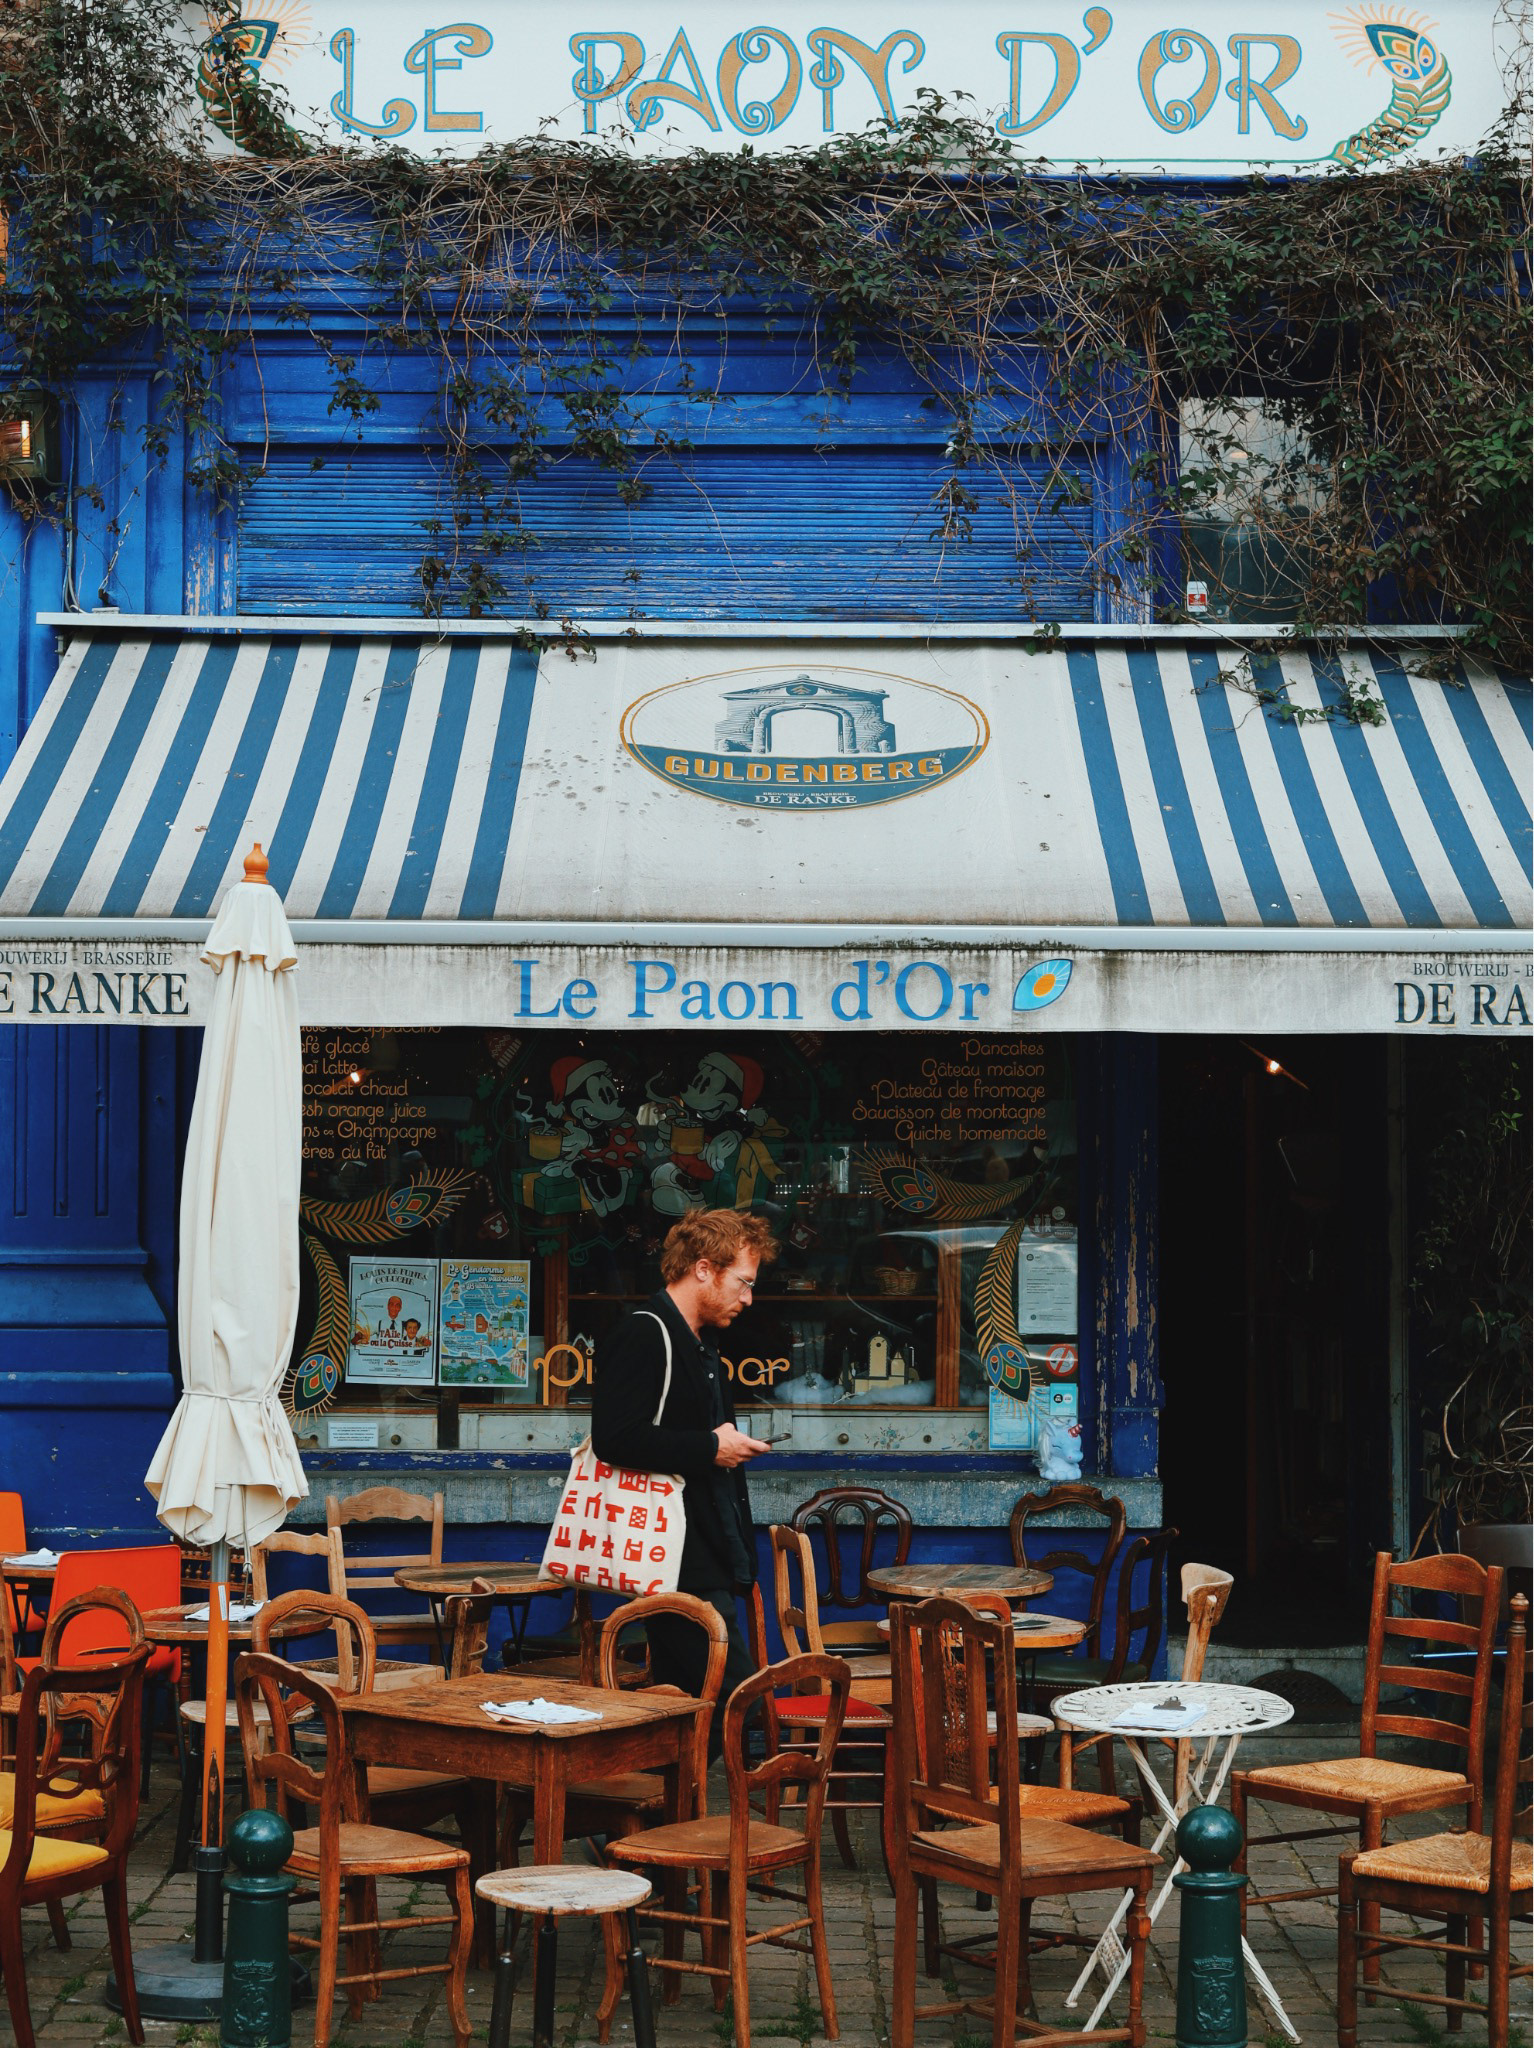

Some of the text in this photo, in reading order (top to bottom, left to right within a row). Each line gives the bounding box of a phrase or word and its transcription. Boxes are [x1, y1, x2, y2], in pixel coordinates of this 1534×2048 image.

[329, 22, 494, 138] LE
[568, 25, 926, 137] PAON
[664, 754, 944, 783] GULDENBERG
[755, 795, 857, 805] DE RANKE
[83, 950, 173, 967] BRASSERIE
[1413, 962, 1509, 977] BROUWERIJ
[28, 971, 190, 1016] RANKE
[512, 959, 989, 1022] Le Paon d'Or
[1394, 982, 1456, 1026] DE
[325, 1036, 370, 1060] glacé
[961, 1038, 1045, 1062] Pancakes
[322, 1057, 358, 1075] latte
[921, 1058, 1045, 1086] Gâteau maison
[360, 1079, 408, 1096] chaud
[871, 1078, 1046, 1106] Plateau de fromage
[328, 1105, 384, 1126] orange
[390, 1102, 427, 1123] juice
[852, 1099, 1047, 1125] Saucisson de montagne
[337, 1119, 437, 1147] Champagne
[959, 1123, 1047, 1141] homemade
[360, 1268, 387, 1281] LOUIS
[375, 1275, 415, 1286] COLUCHE
[462, 1264, 506, 1281] Gendarme
[370, 1338, 413, 1349] ou la Cuisse
